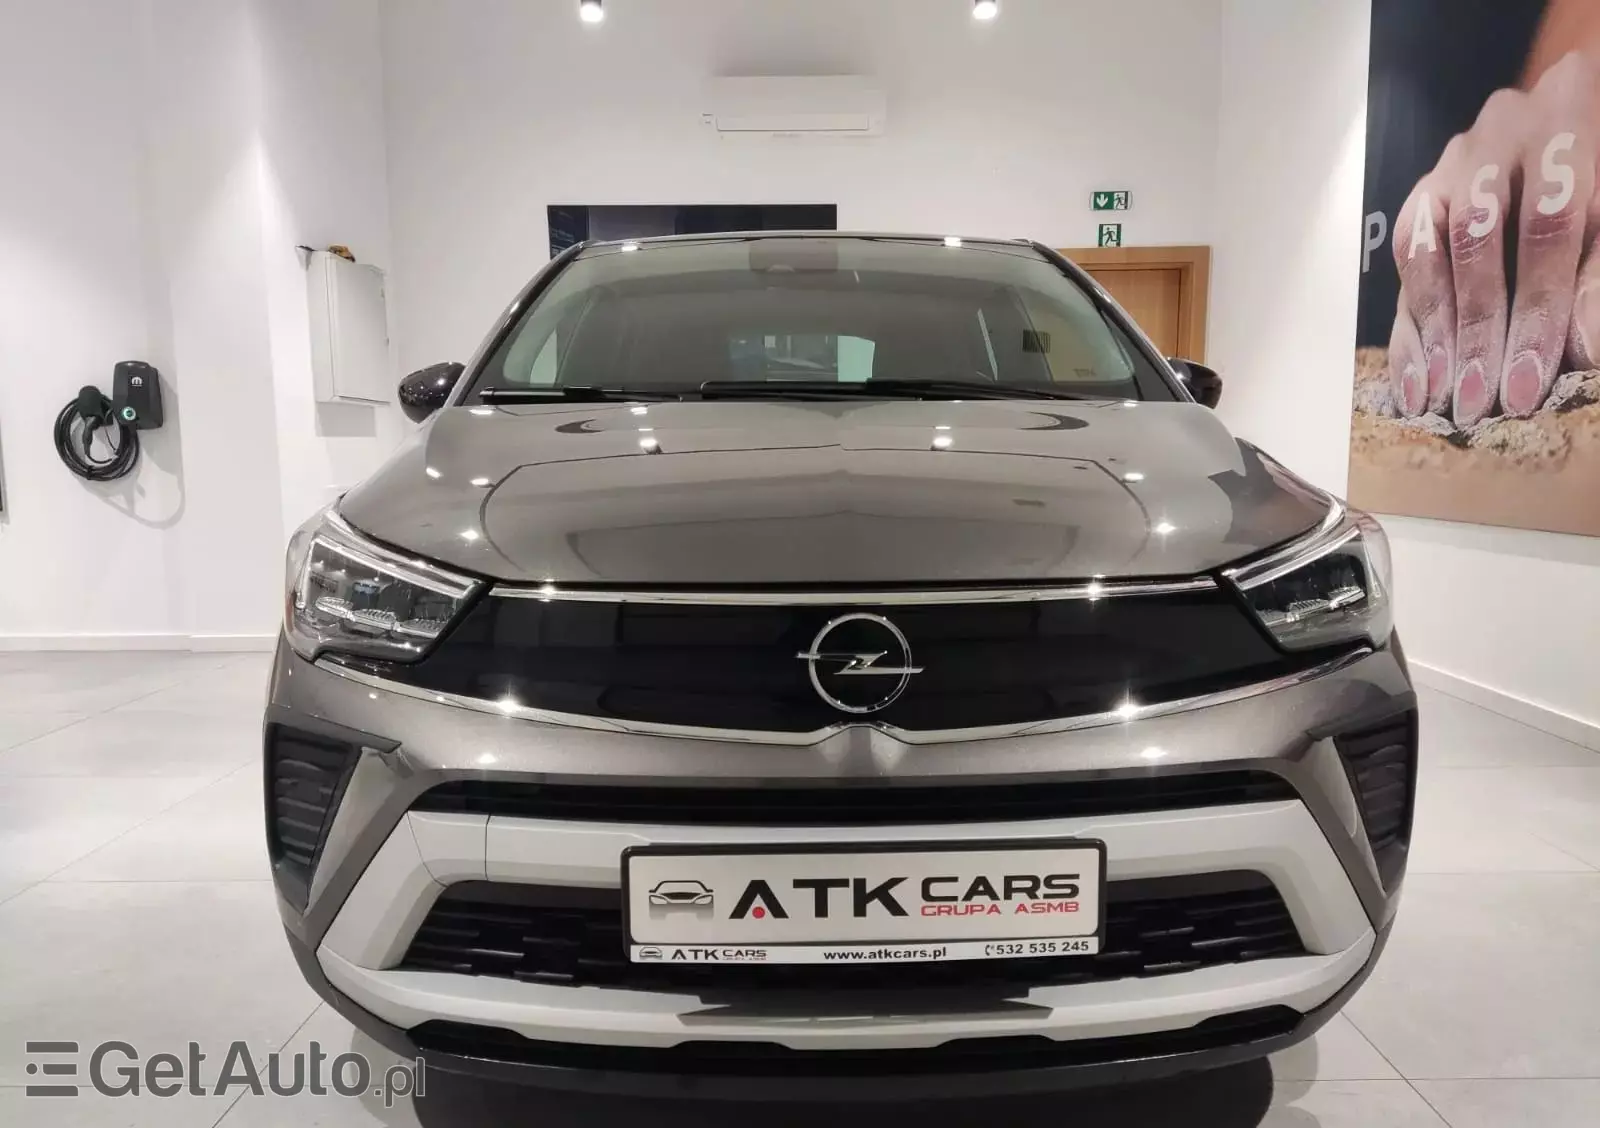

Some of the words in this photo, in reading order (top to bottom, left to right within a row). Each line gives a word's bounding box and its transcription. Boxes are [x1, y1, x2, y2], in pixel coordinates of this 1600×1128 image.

[728, 877, 909, 919] ATK
[921, 874, 1080, 902] CARS
[920, 904, 1002, 917] GRUPA
[1014, 901, 1080, 915] ASMB
[671, 948, 720, 960] ATK
[722, 949, 767, 958] CARS
[823, 946, 947, 960] www.atkcars.pl
[996, 944, 1024, 955] 532
[1029, 942, 1057, 954] 535
[1061, 940, 1089, 952] 245
